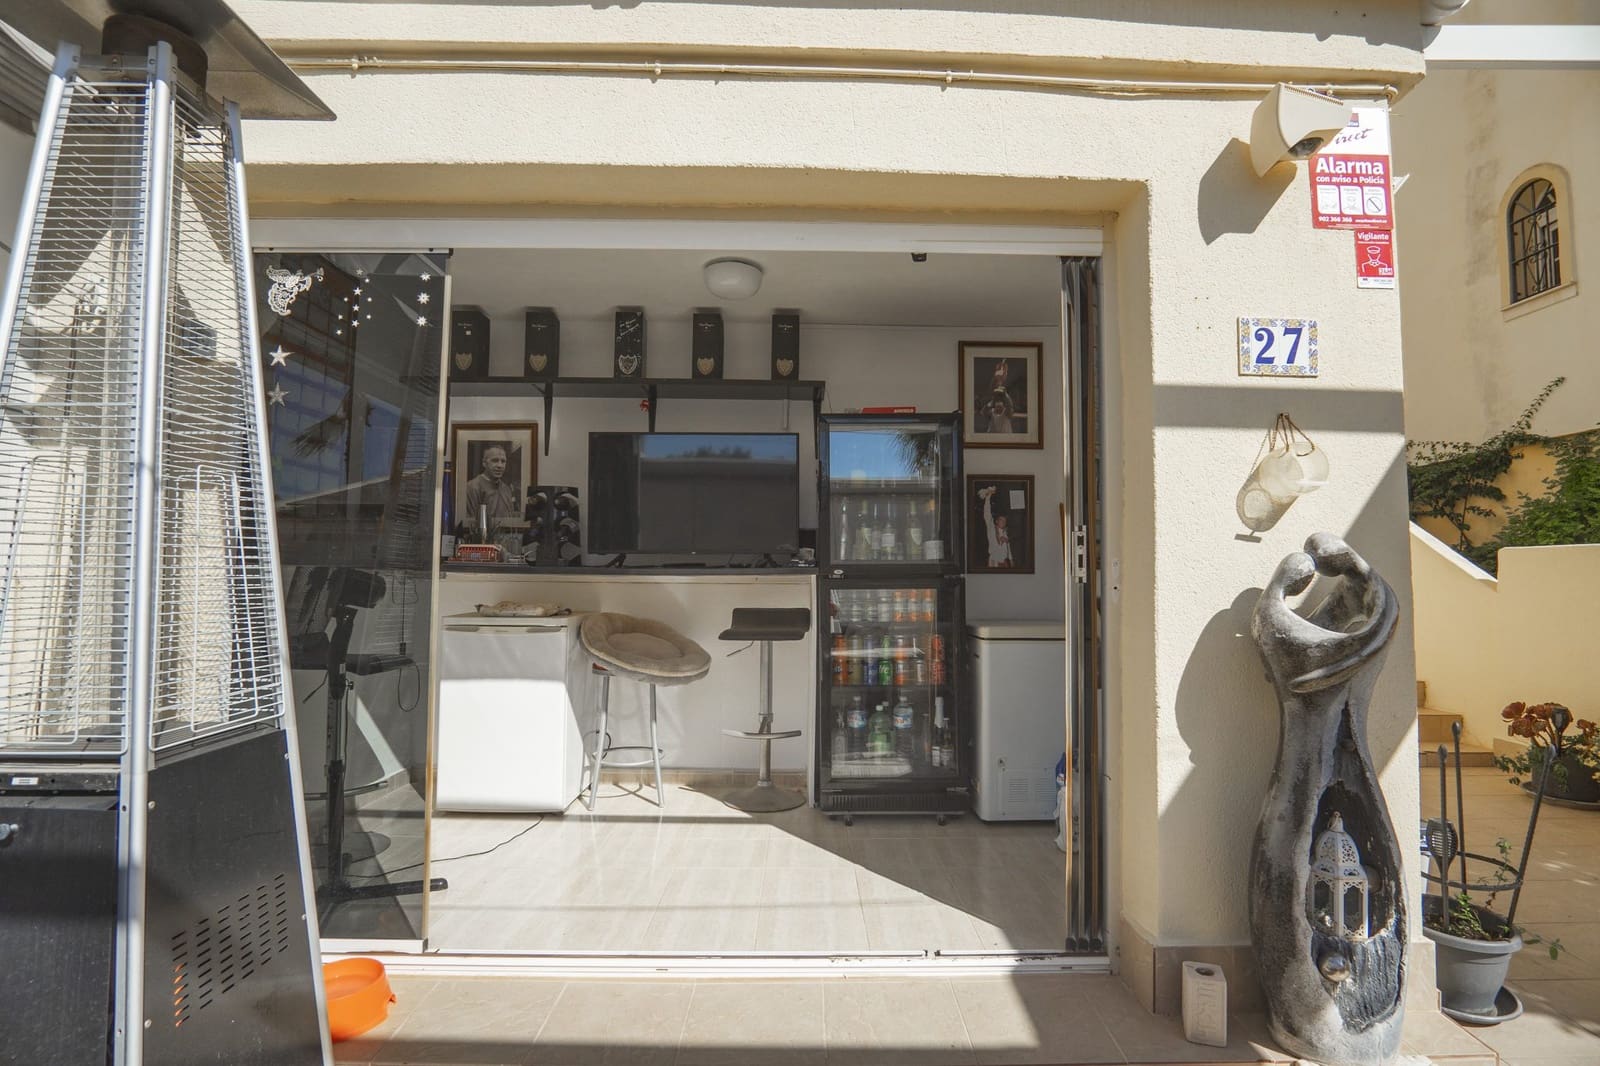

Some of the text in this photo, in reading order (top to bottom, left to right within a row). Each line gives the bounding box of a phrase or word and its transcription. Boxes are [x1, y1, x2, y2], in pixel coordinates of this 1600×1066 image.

[1335, 128, 1374, 144] irect
[1316, 157, 1384, 175] Alarma
[1331, 174, 1352, 183] aviso
[1358, 232, 1389, 241] Vigilante
[1254, 327, 1303, 364] 27
